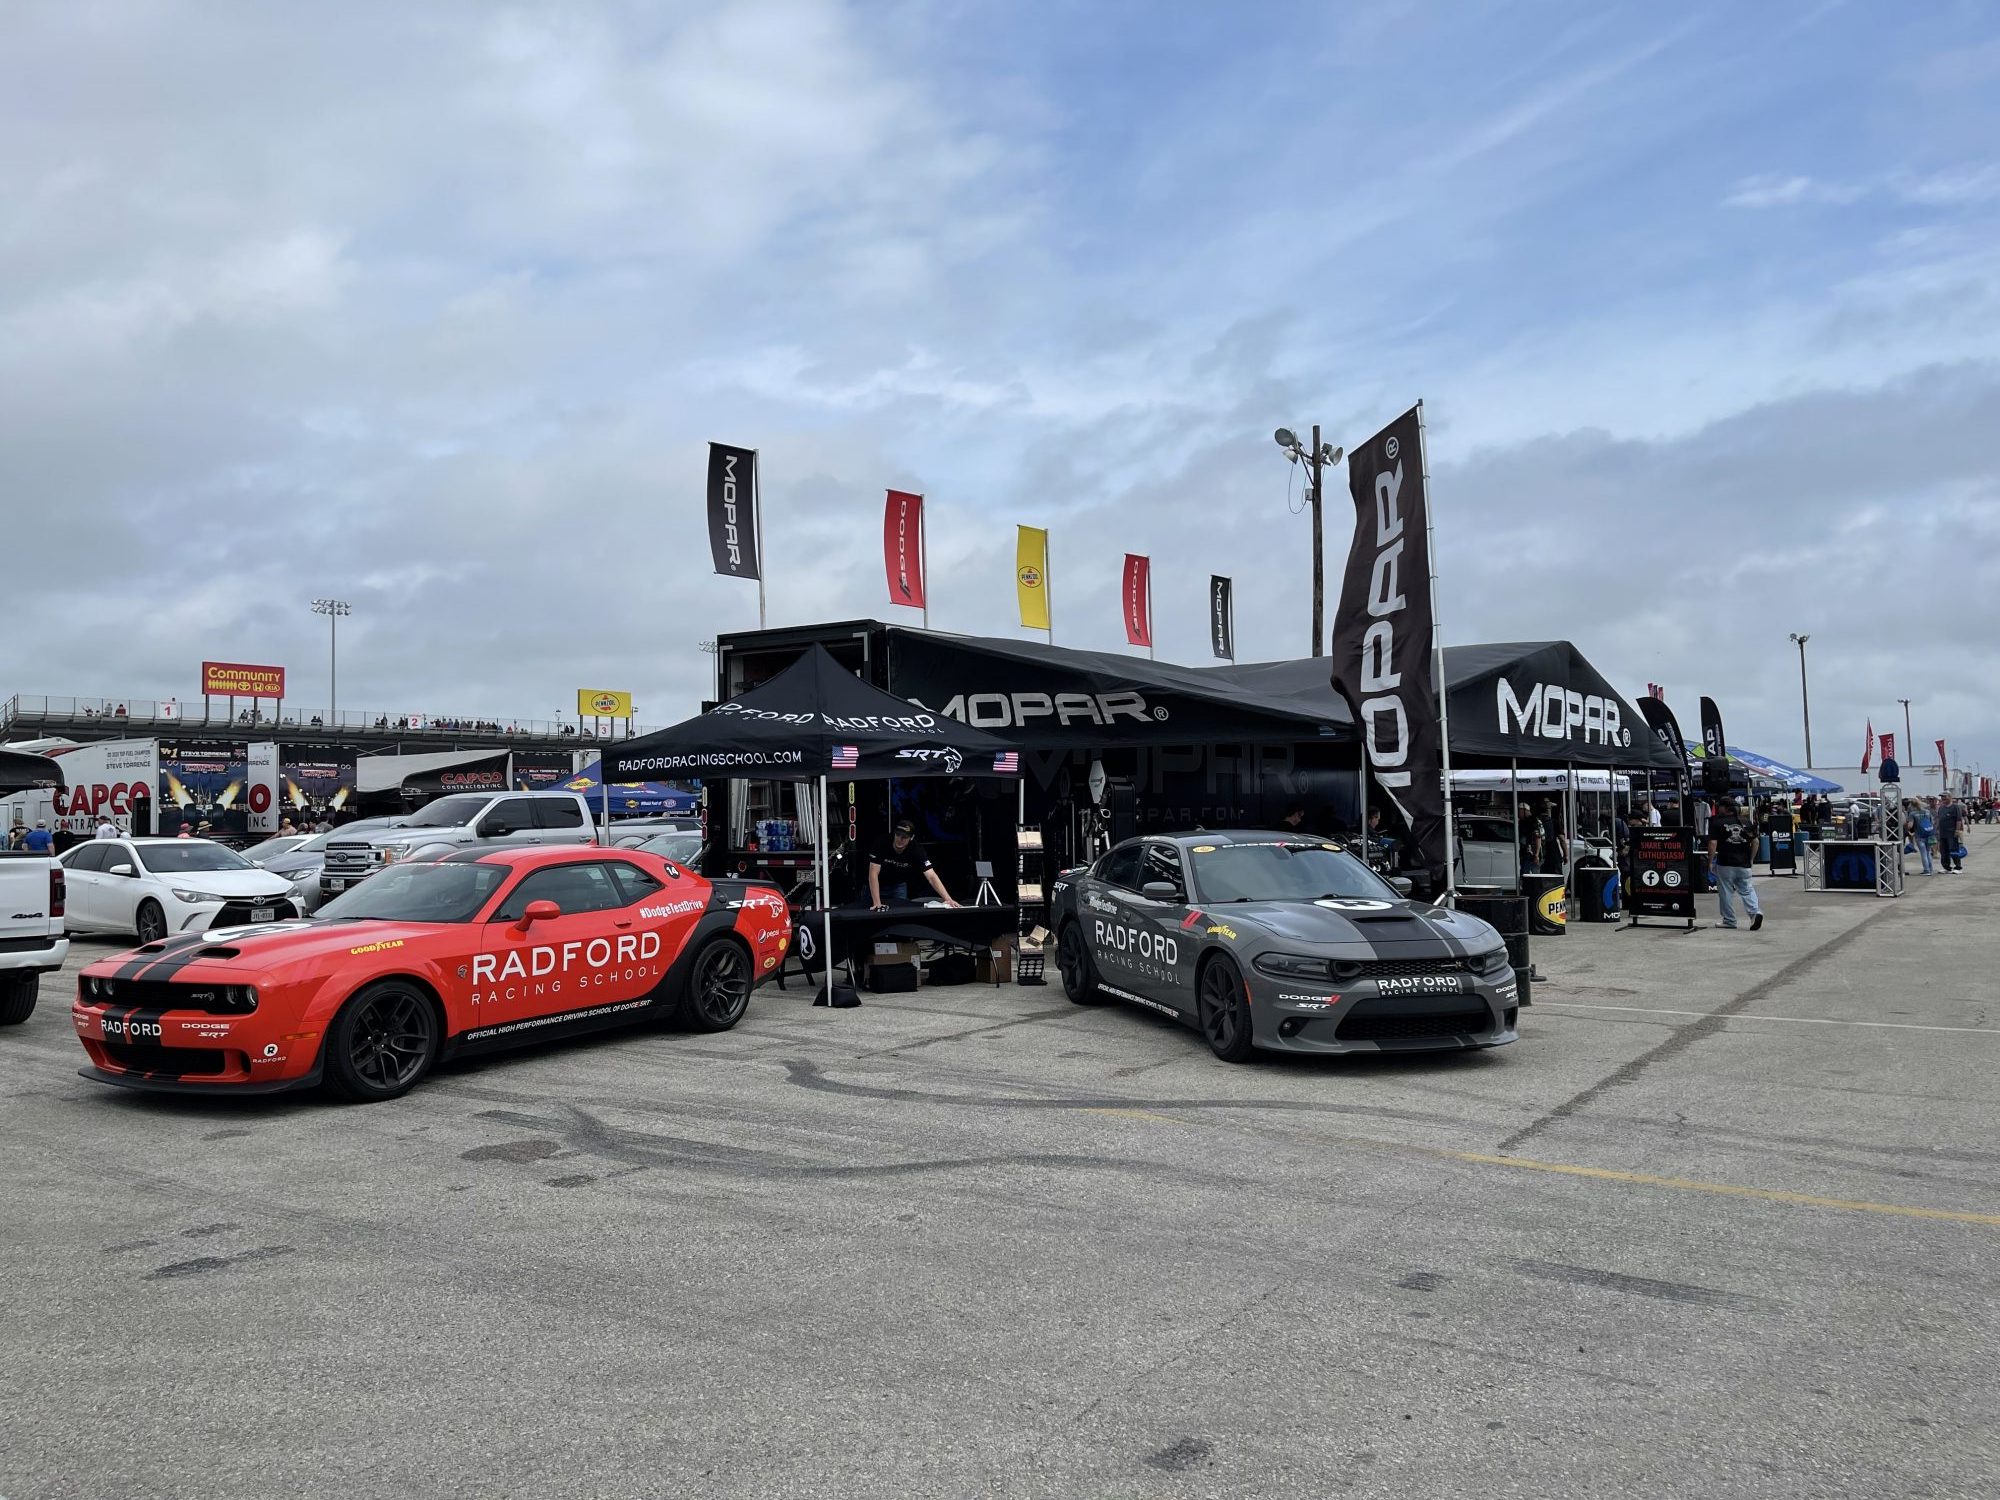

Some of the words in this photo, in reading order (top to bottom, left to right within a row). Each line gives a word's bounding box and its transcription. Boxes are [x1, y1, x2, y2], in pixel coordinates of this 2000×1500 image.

[724, 455, 741, 566] MOPAR
[899, 501, 909, 587] DODGE
[1216, 582, 1225, 651] MOPAR
[411, 718, 418, 727] 2
[821, 711, 935, 729] RADFORD
[618, 750, 802, 772] RADFORDRACINGSCHOOL.COM
[895, 749, 946, 761] SRT
[441, 771, 503, 784] CAPCO
[1640, 841, 1661, 849] SHARE
[1638, 850, 1685, 860] ENTHUSIASM
[666, 866, 679, 876] 14
[1656, 861, 1666, 869] ON
[640, 900, 704, 919] #DodgeTestDrive
[726, 898, 769, 910] SRT
[766, 929, 780, 939] pepsi
[351, 940, 405, 955] GOODYEAR
[1095, 920, 1178, 965] RADFORD
[472, 931, 661, 986] RADFORD
[1097, 949, 1133, 969] RACING
[1140, 962, 1181, 985] SCHOOL
[472, 981, 561, 1006] RACING
[579, 965, 659, 988] SCHOOL
[1378, 976, 1457, 990] RADFORD
[1278, 993, 1332, 1001] DODGE
[101, 1019, 162, 1036] RADFORD
[467, 1028, 498, 1040] OFFICIAL
[498, 1024, 516, 1034] HIGH
[516, 1015, 563, 1031] PERFORMANCE
[563, 1010, 588, 1021] DRIVING
[588, 1006, 612, 1017] SCHOOL
[612, 1004, 621, 1012] OF
[198, 1031, 229, 1039] SRT
